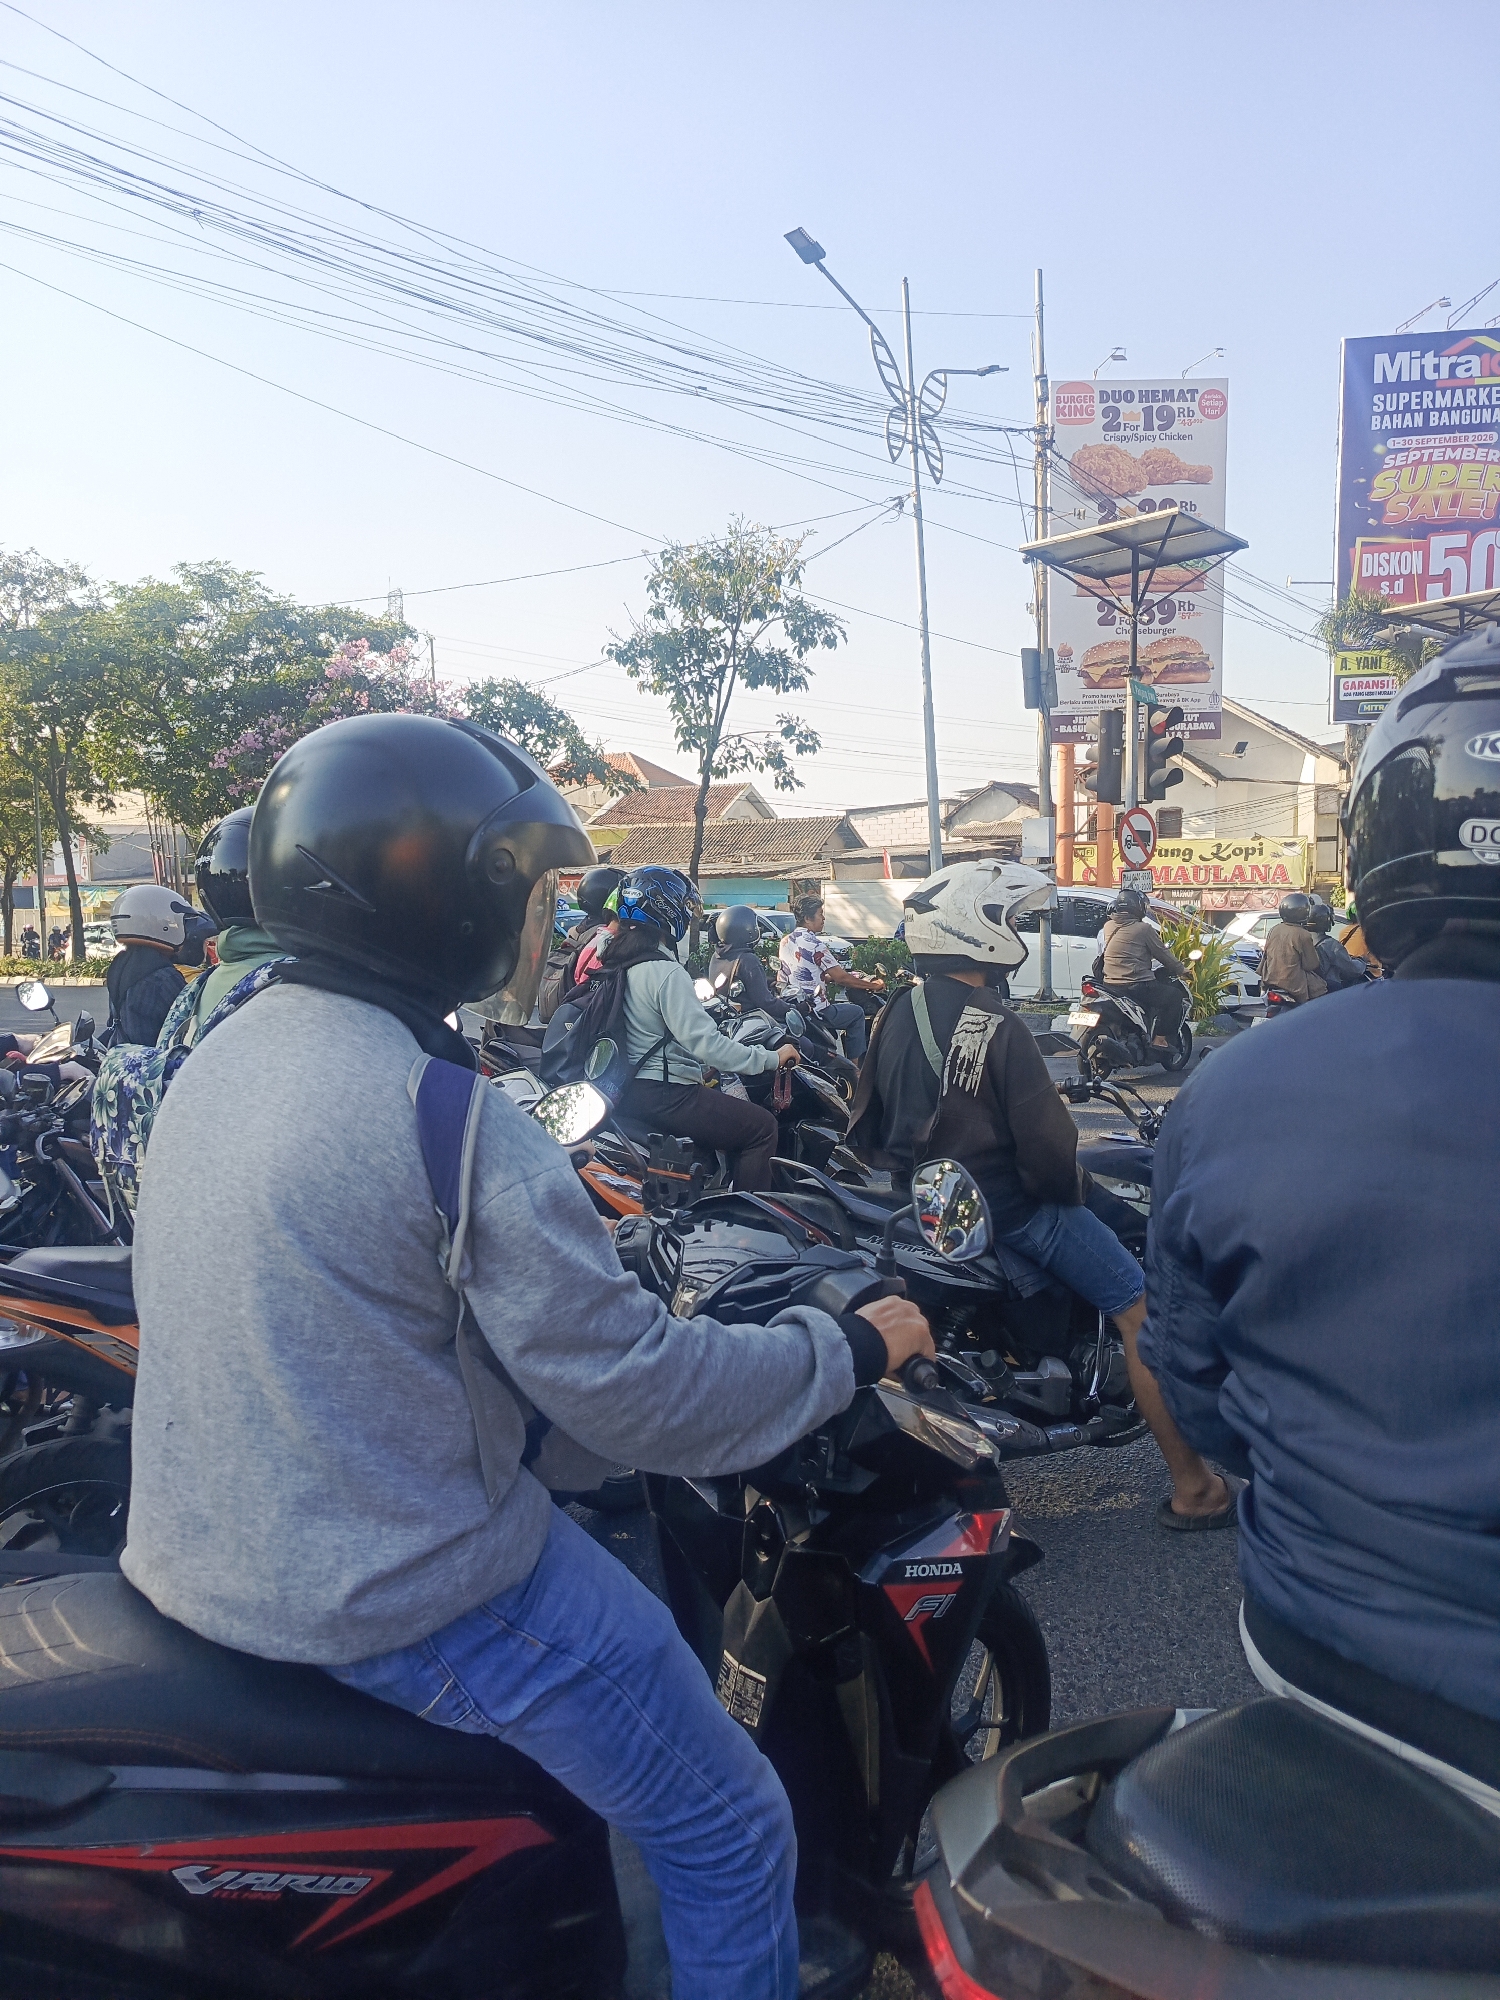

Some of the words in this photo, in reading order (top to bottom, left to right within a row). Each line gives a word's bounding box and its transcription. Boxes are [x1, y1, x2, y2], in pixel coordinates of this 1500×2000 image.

[1055, 395, 1095, 404] BURGER
[1099, 390, 1135, 404] DUO
[1138, 389, 1199, 403] HEMAT
[1202, 399, 1224, 408] Setiap
[1055, 405, 1095, 417] KING
[1101, 405, 1121, 432] 2
[1123, 423, 1140, 431] For
[1142, 405, 1176, 431] 19
[1177, 407, 1195, 418] Rb
[1371, 411, 1424, 430] BAHAN
[1104, 433, 1157, 443] Crispy/Spicy
[1159, 433, 1193, 441] Chicken
[1415, 435, 1470, 445] SEPTEMBER
[1383, 490, 1499, 525] SALE!
[1362, 551, 1423, 577] DISKON
[1380, 578, 1404, 595] s.d
[1097, 600, 1116, 626] 2
[1178, 601, 1196, 612] Rb
[1115, 626, 1176, 636] Chseburger
[1343, 680, 1389, 691] GARANSI
[1199, 842, 1264, 862] Kopi
[1151, 864, 1292, 885] MAULANA
[905, 1563, 963, 1577] HONDA
[904, 1593, 957, 1621] FI
[172, 1865, 372, 1895] VARIO
